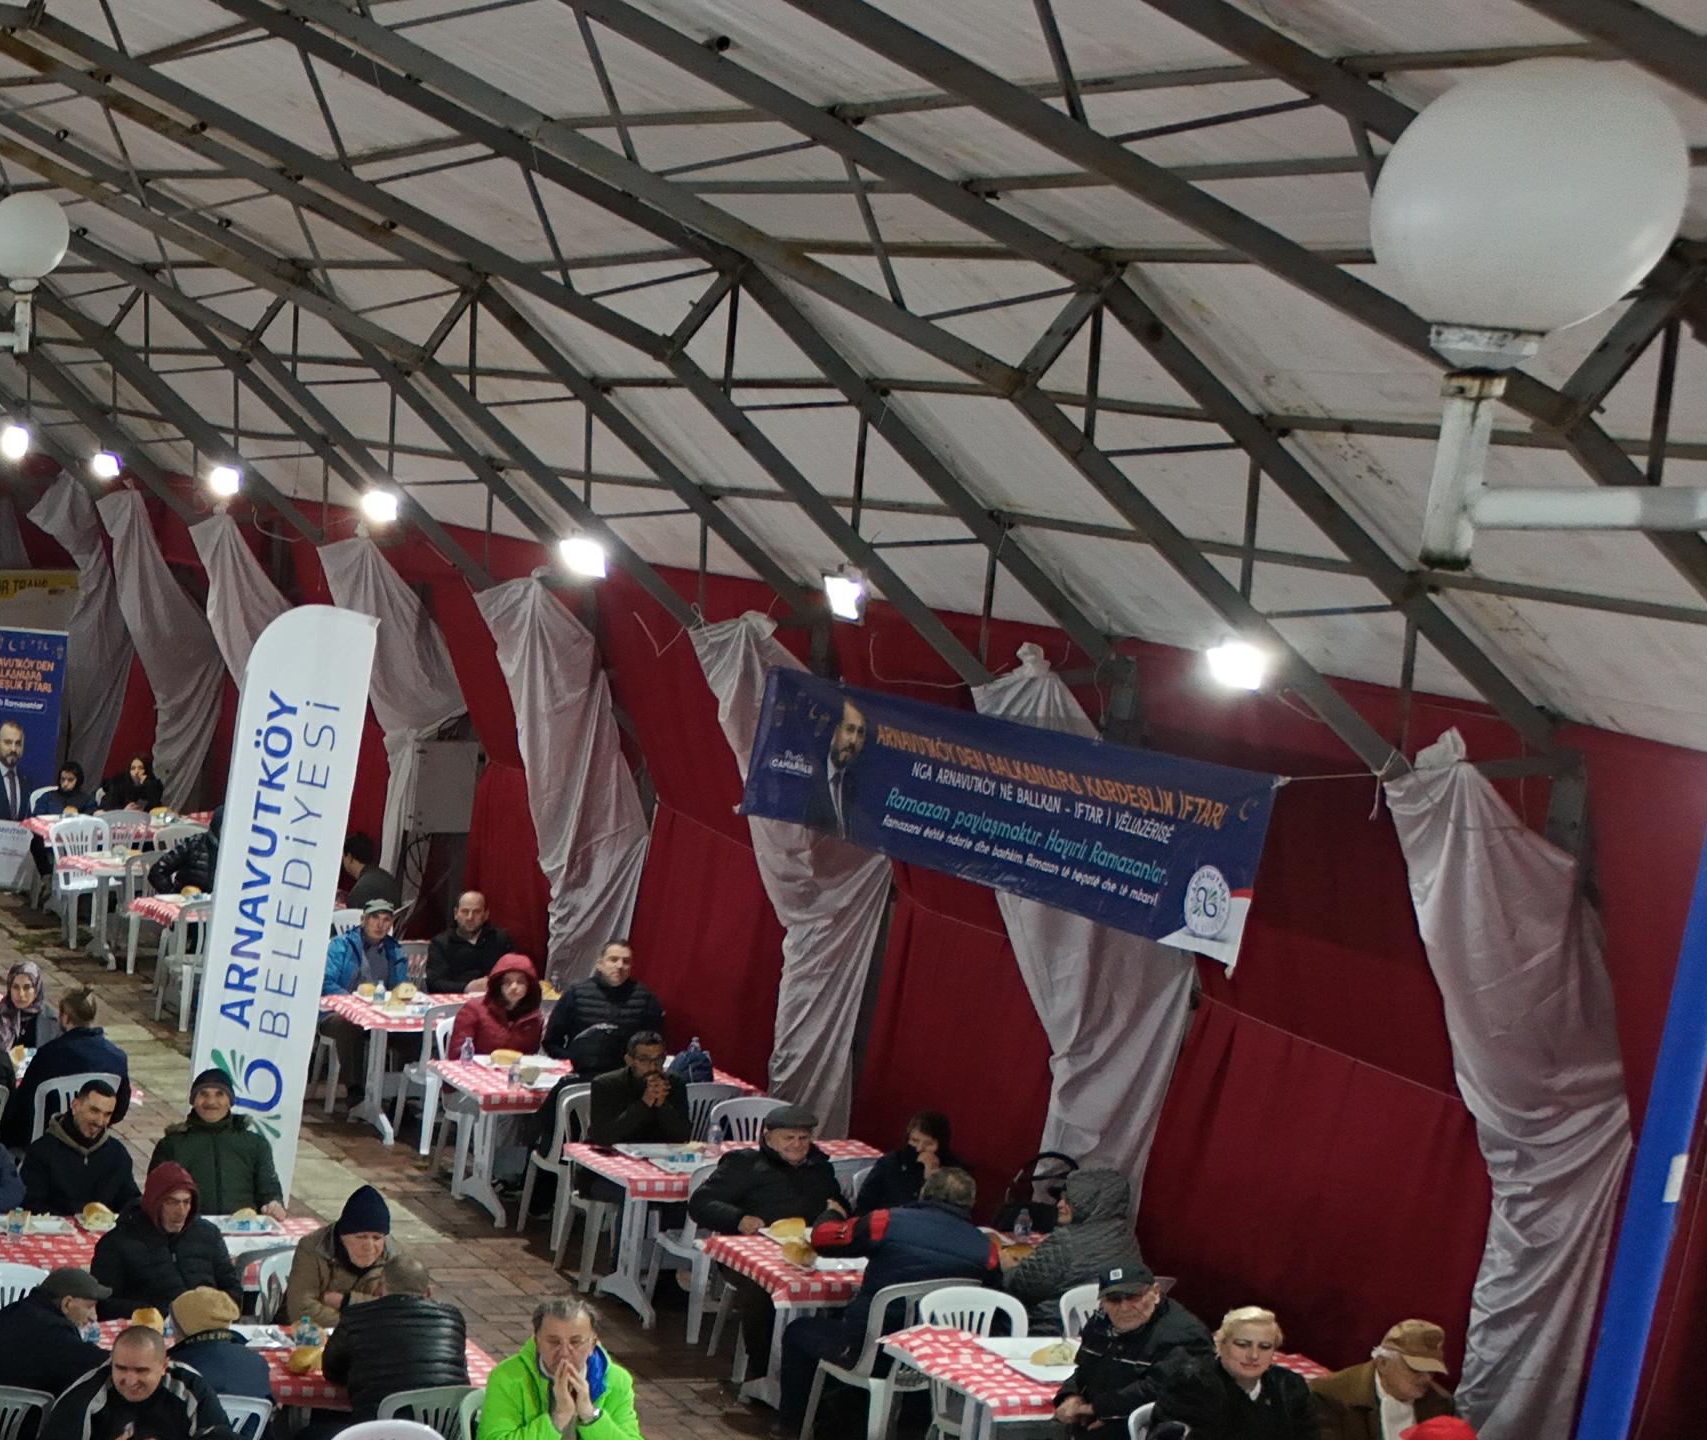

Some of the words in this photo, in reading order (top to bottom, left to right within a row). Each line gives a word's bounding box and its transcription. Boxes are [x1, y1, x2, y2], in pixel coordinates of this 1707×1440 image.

[885, 786, 951, 822] Ramazan
[1044, 828, 1088, 860] Hayırlı
[911, 761, 933, 782] NGA
[935, 767, 997, 797] ARNAVUTKÖY
[1016, 787, 1062, 814] BALLKAN
[1073, 801, 1104, 827] IFTAR
[1083, 775, 1175, 818] KARDEŞLİK
[1178, 790, 1229, 830] İFTARI
[220, 690, 297, 1029] ARNAVUTKÖY
[259, 701, 339, 1038] BELEDİYESİ
